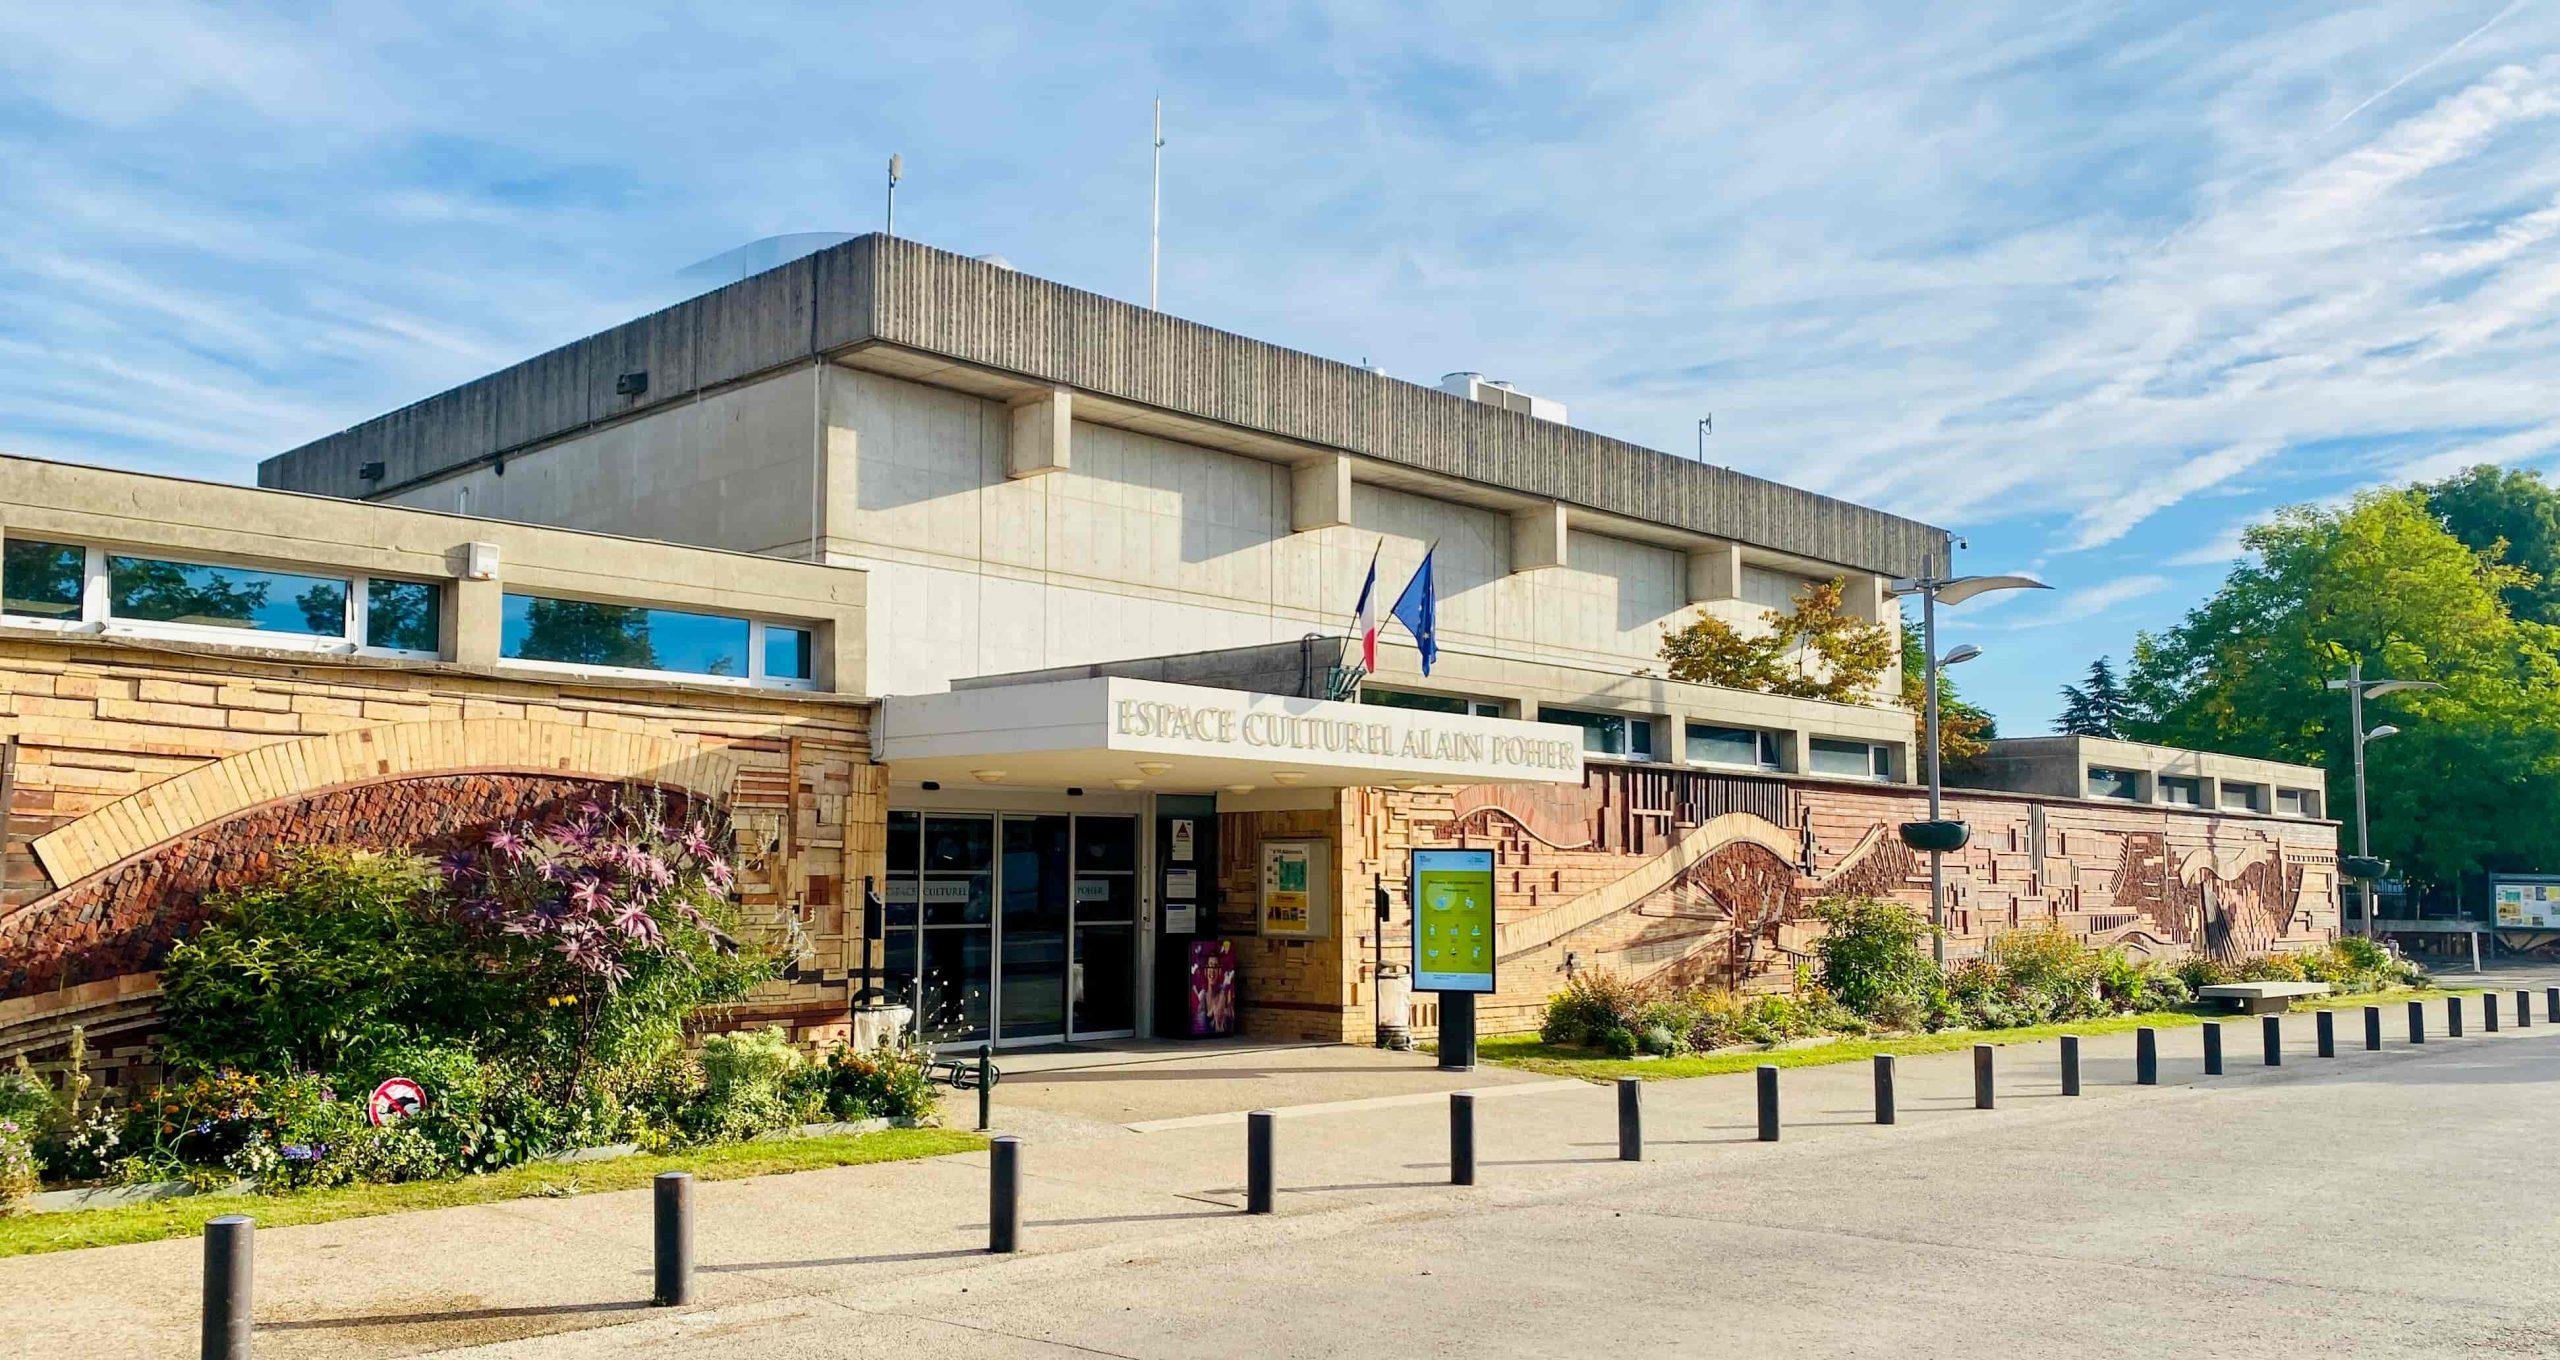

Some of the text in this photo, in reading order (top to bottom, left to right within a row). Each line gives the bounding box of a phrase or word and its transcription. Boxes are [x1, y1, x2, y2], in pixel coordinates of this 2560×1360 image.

[1114, 698, 1577, 771] ESPACE CULTUREL ALAIN POHER
[922, 886, 967, 897] CULTUREL
